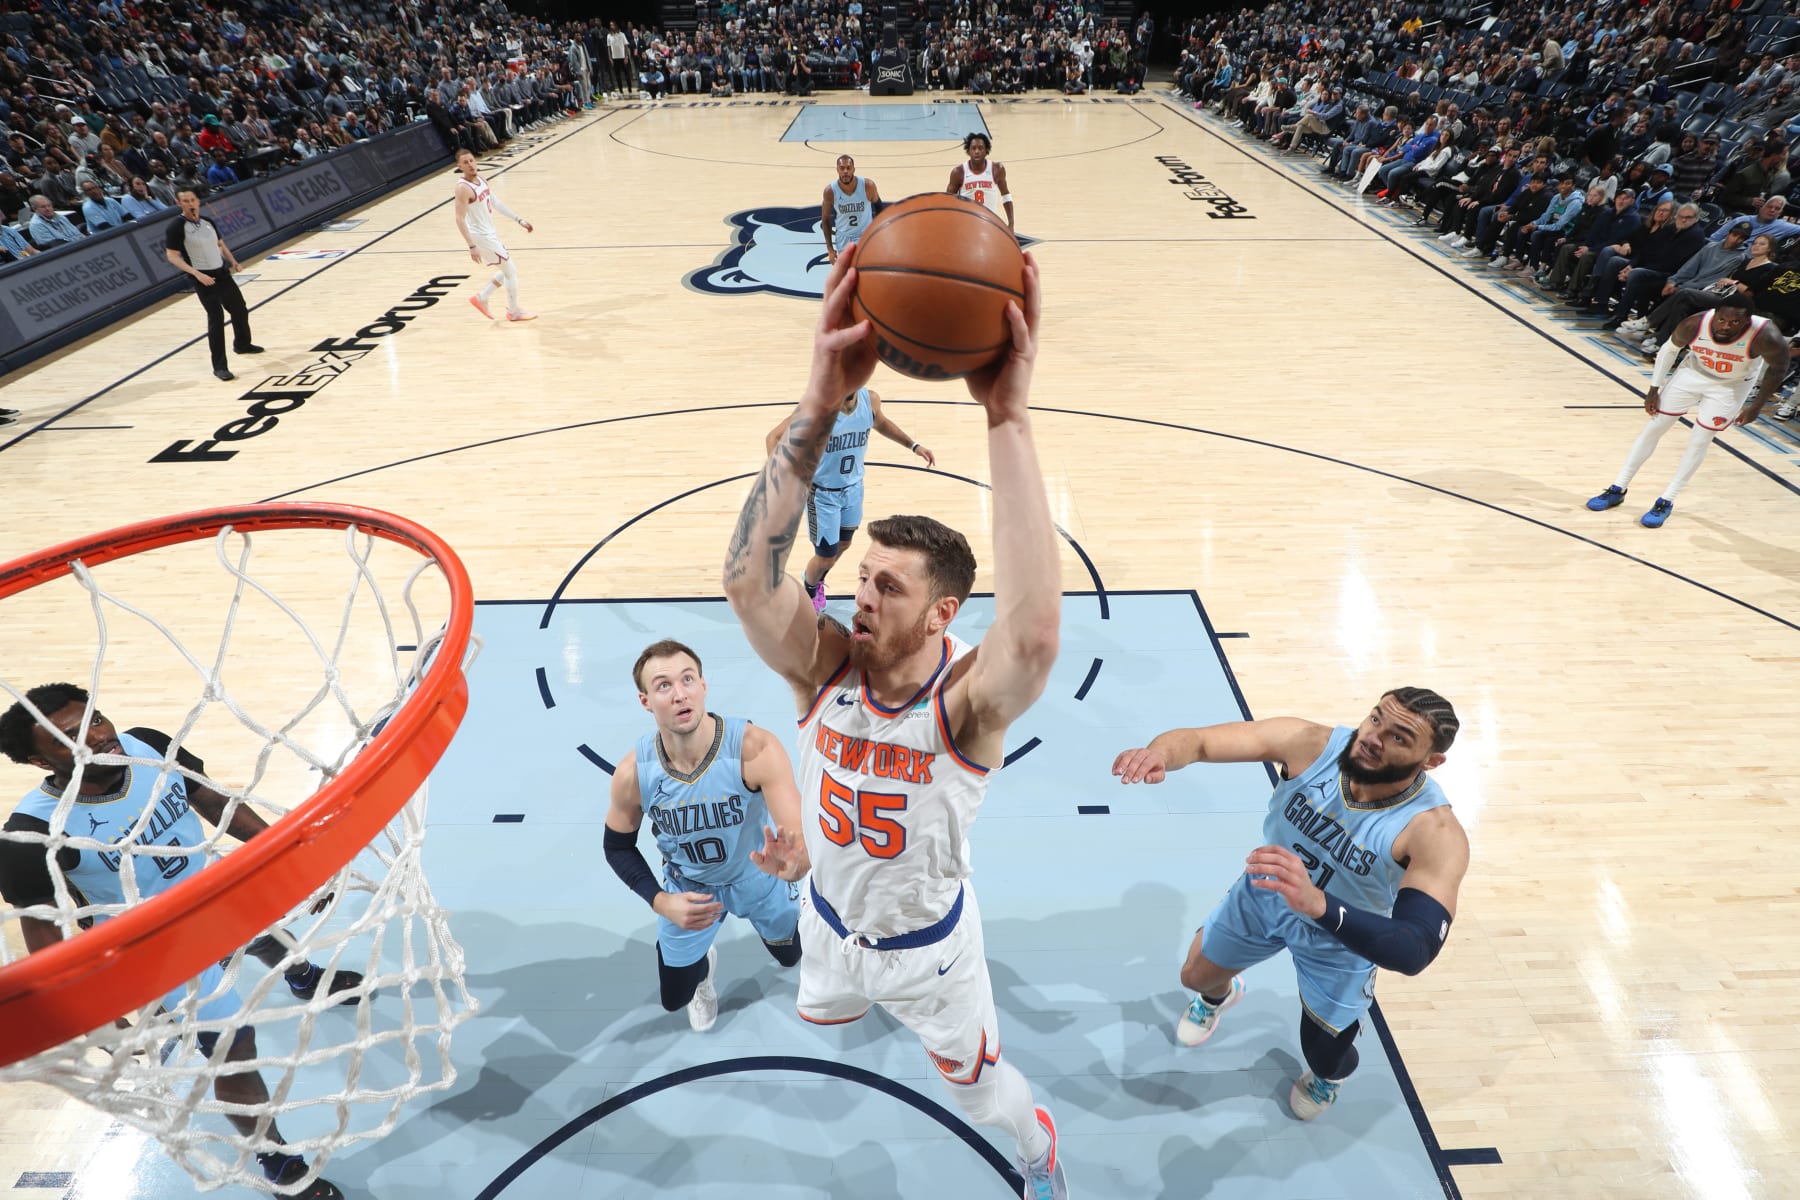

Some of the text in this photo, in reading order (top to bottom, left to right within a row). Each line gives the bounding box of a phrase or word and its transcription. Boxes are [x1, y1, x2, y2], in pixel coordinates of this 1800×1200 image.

[881, 70, 902, 78] SONIC
[267, 170, 341, 215] 45 YEARS
[965, 182, 978, 190] NEW
[1154, 156, 1257, 219] FedExForum
[838, 201, 865, 213] GRIZZLIES
[849, 216, 858, 227] 2
[10, 264, 90, 306] AMERICA'S
[84, 251, 122, 276] BEST
[26, 266, 139, 322] SELLING TRUCKS
[147, 275, 471, 463] FedExForum
[1692, 345, 1745, 363] NEW YORK
[1700, 356, 1733, 373] 30
[826, 428, 871, 453] GRIZZLIES
[840, 455, 856, 475] 0
[816, 721, 936, 785] NEW YORK
[650, 795, 745, 836] GRIZZLIES
[819, 768, 908, 860] 55
[1284, 792, 1378, 877] GRIZZLIES
[152, 837, 189, 880] 5
[679, 837, 727, 865] 10
